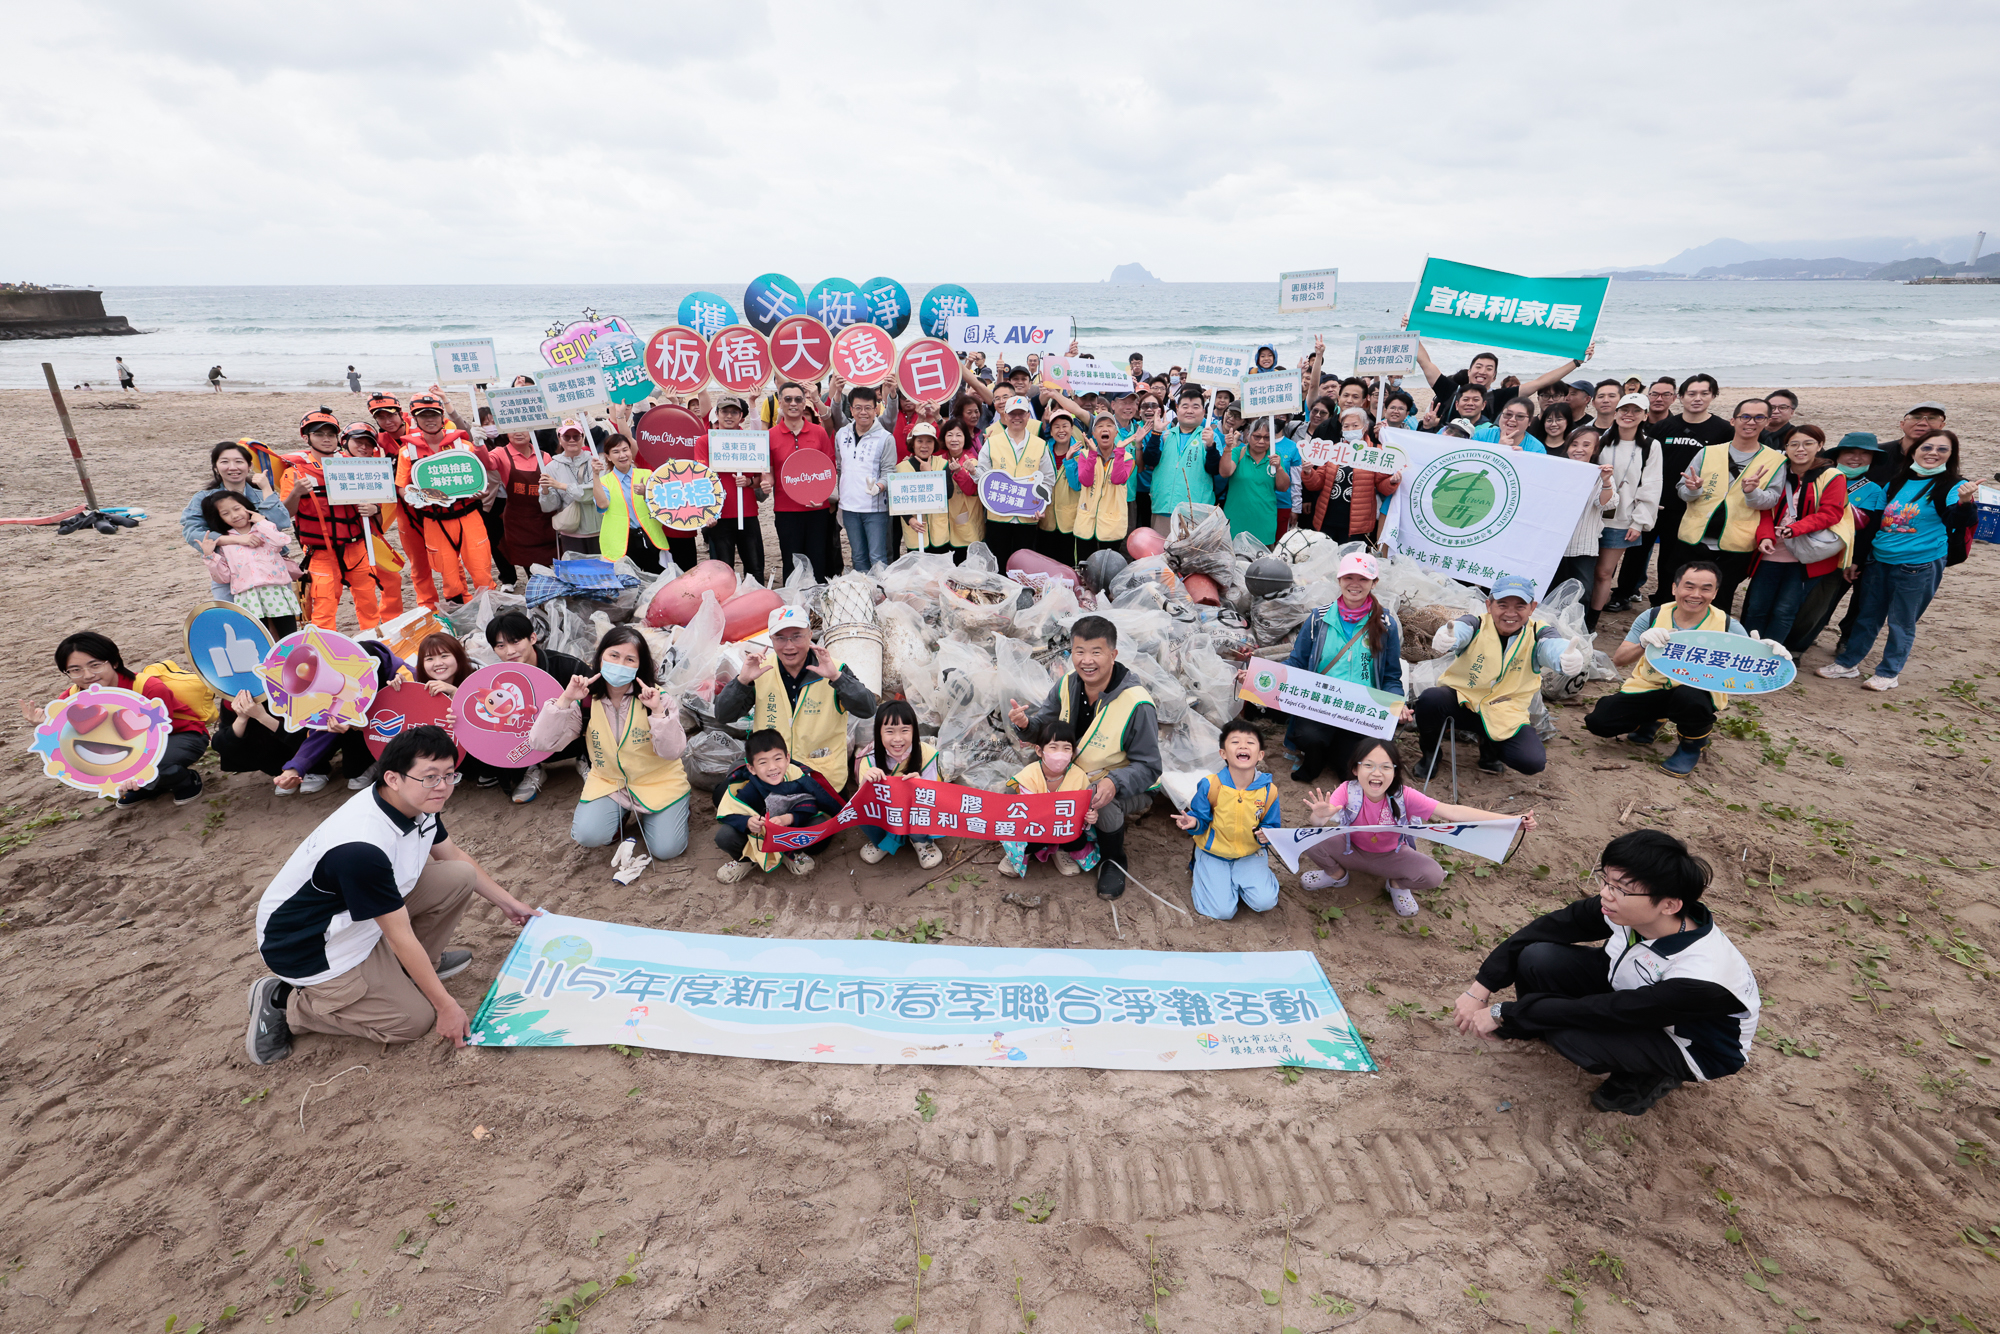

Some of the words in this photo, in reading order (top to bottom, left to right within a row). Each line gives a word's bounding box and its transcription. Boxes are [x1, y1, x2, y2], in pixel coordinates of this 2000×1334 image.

[1291, 281, 1325, 292] 圓展科技
[1291, 291, 1325, 302] 有限公司
[690, 300, 727, 339] 攜
[755, 281, 798, 324] 手
[817, 287, 858, 331] 挺
[864, 284, 901, 330] 淨
[931, 294, 969, 337] 灘
[1424, 285, 1583, 332] 宜得利家居
[963, 324, 1000, 345] 圓展
[1003, 325, 1054, 345] AVer
[1364, 344, 1410, 355] 宜得利家居
[451, 351, 478, 362] 萬里區
[652, 333, 701, 384] 板
[716, 334, 762, 384] 橋
[779, 326, 824, 372] 大
[838, 331, 889, 380] 遠
[906, 347, 948, 396] 百
[1198, 354, 1242, 367] 新北市醫事
[1358, 354, 1413, 366] 股份有限公司
[453, 363, 480, 374] 龜吼里
[1197, 364, 1241, 377] 檢驗師公會
[547, 375, 597, 393] 福泰翡翠灣
[1249, 382, 1293, 396] 新北市政府
[556, 388, 595, 403] 渡假飯店
[1249, 393, 1293, 406] 環境保護局
[499, 405, 546, 416] 北海岸及觀音
[722, 442, 756, 451] 遠東百貨
[713, 452, 765, 461] 股份有限公司
[428, 462, 473, 476] 垃圾撿起
[1439, 452, 1481, 467] ASSOCIATION
[1491, 457, 1513, 479] MEDICAL
[328, 471, 390, 481] 海巡署北部分署
[429, 475, 475, 488] 海好有你
[784, 476, 800, 485] Mega
[800, 473, 812, 484] City
[339, 482, 384, 491] 第二岸巡隊
[653, 476, 717, 510] 板橋
[900, 483, 935, 494] 南亞塑膠
[990, 479, 1028, 497] 攜手淨灘
[892, 494, 943, 505] 股份有限公司
[987, 490, 1025, 508] 清淨海灘
[1661, 642, 1781, 677] 環保愛地球
[1315, 681, 1342, 694] 社團法人
[1278, 682, 1390, 721] 新北市醫事檢驗師公會
[1284, 698, 1298, 707] Taipei
[1298, 702, 1307, 710] City
[1307, 704, 1331, 717] Association
[1337, 714, 1355, 723] medical
[1355, 718, 1384, 731] Technologist
[837, 801, 1076, 838] 泰山區福利會愛心社
[521, 958, 1320, 1028] 115年度新北市春季聯合淨灘活動
[1221, 1032, 1292, 1045] 新北市政府
[1230, 1045, 1292, 1055] 環境保護局
